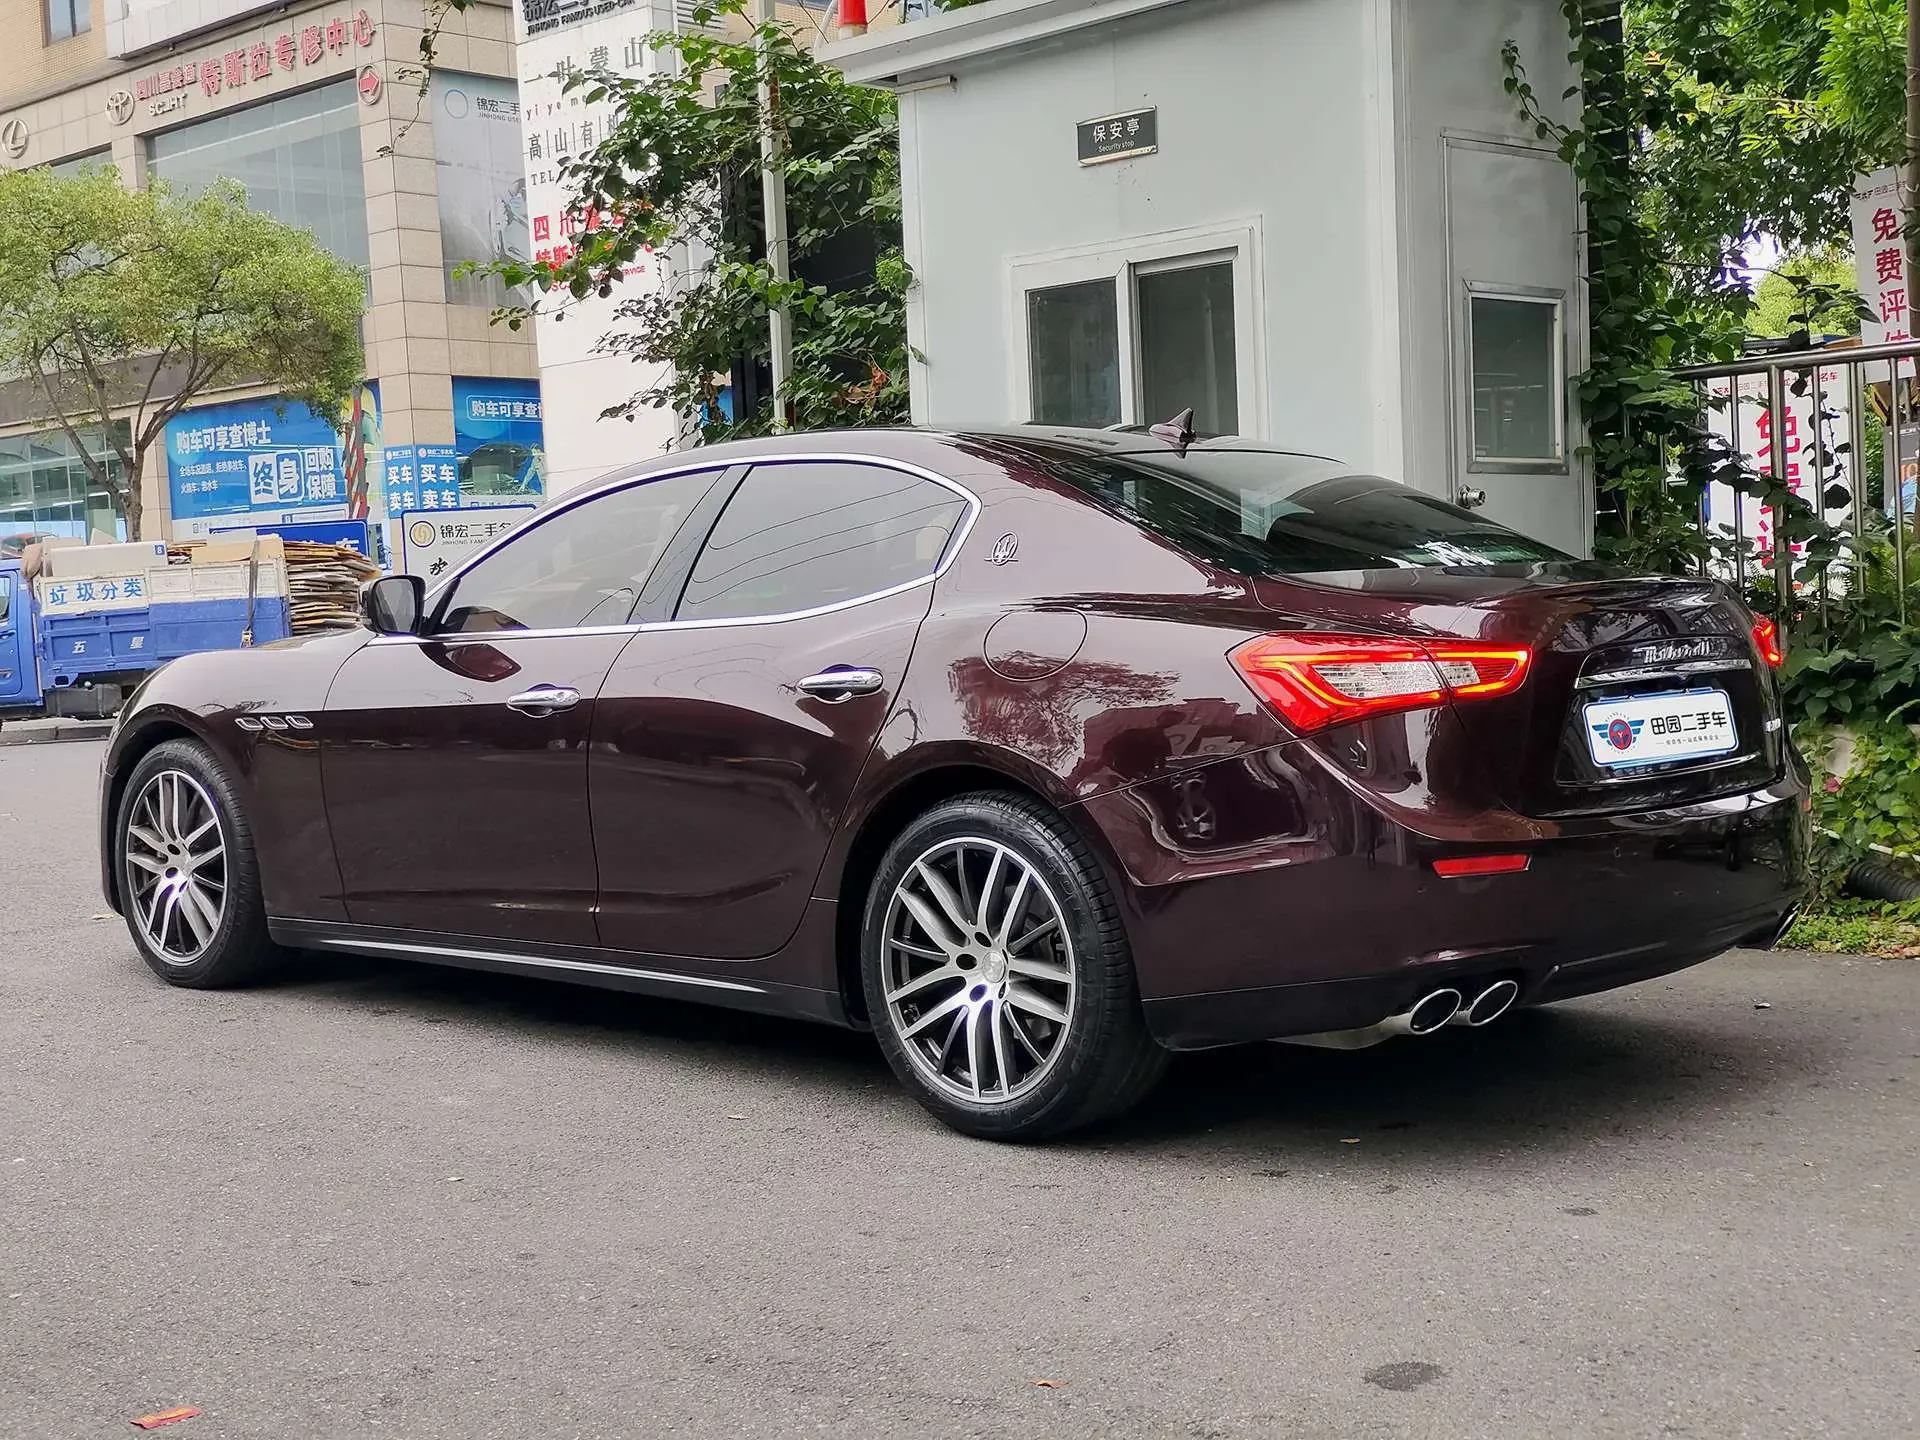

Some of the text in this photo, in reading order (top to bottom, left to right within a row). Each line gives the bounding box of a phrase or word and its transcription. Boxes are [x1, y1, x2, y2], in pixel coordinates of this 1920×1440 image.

[200, 8, 376, 96] 特斯拉专修中心
[1093, 117, 1140, 143] 保安亭
[1098, 140, 1135, 153] Security stop
[472, 400, 542, 418] 购车可享查
[176, 420, 271, 455] 购车可享查博士
[305, 446, 334, 473] 回购
[253, 457, 299, 497] 终身
[306, 472, 337, 500] 保障
[388, 464, 413, 486] 买车
[420, 463, 456, 484] 买车
[390, 490, 416, 511] 卖车
[422, 489, 458, 509] 卖车
[49, 578, 142, 605] 垃圾分类
[1651, 711, 1728, 735] 田园二手车
